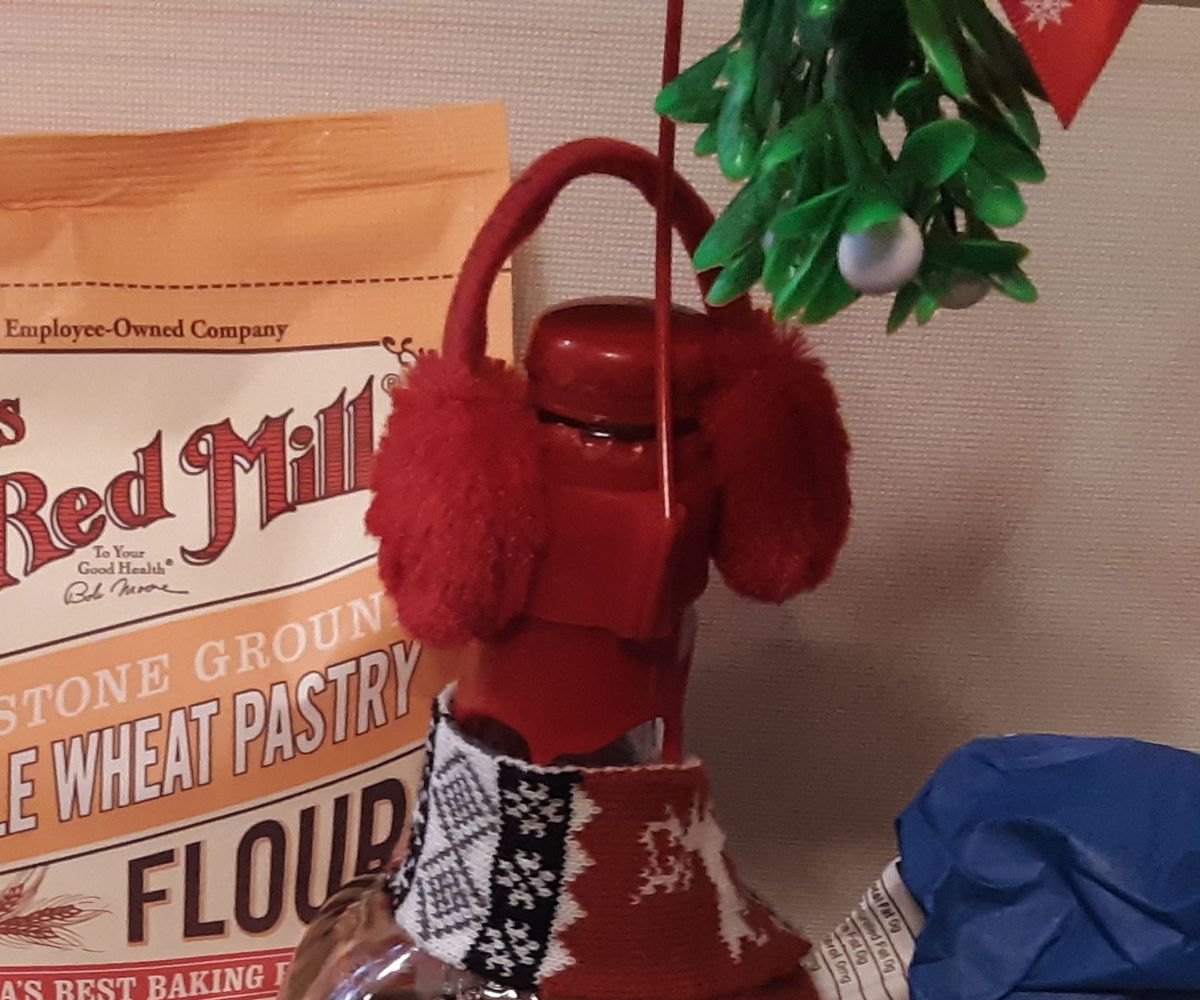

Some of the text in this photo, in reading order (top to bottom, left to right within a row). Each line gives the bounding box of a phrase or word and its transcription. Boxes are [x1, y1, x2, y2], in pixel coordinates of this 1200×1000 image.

[5, 317, 185, 344] Employee-Owned
[190, 318, 289, 345] Company
[179, 375, 380, 567] Mill
[77, 561, 116, 576] Good
[92, 544, 146, 559] To Your
[193, 589, 402, 684] GROUN
[51, 700, 221, 824] WHEAT
[233, 640, 423, 778] PASTRY
[147, 964, 265, 1000] BAKING
